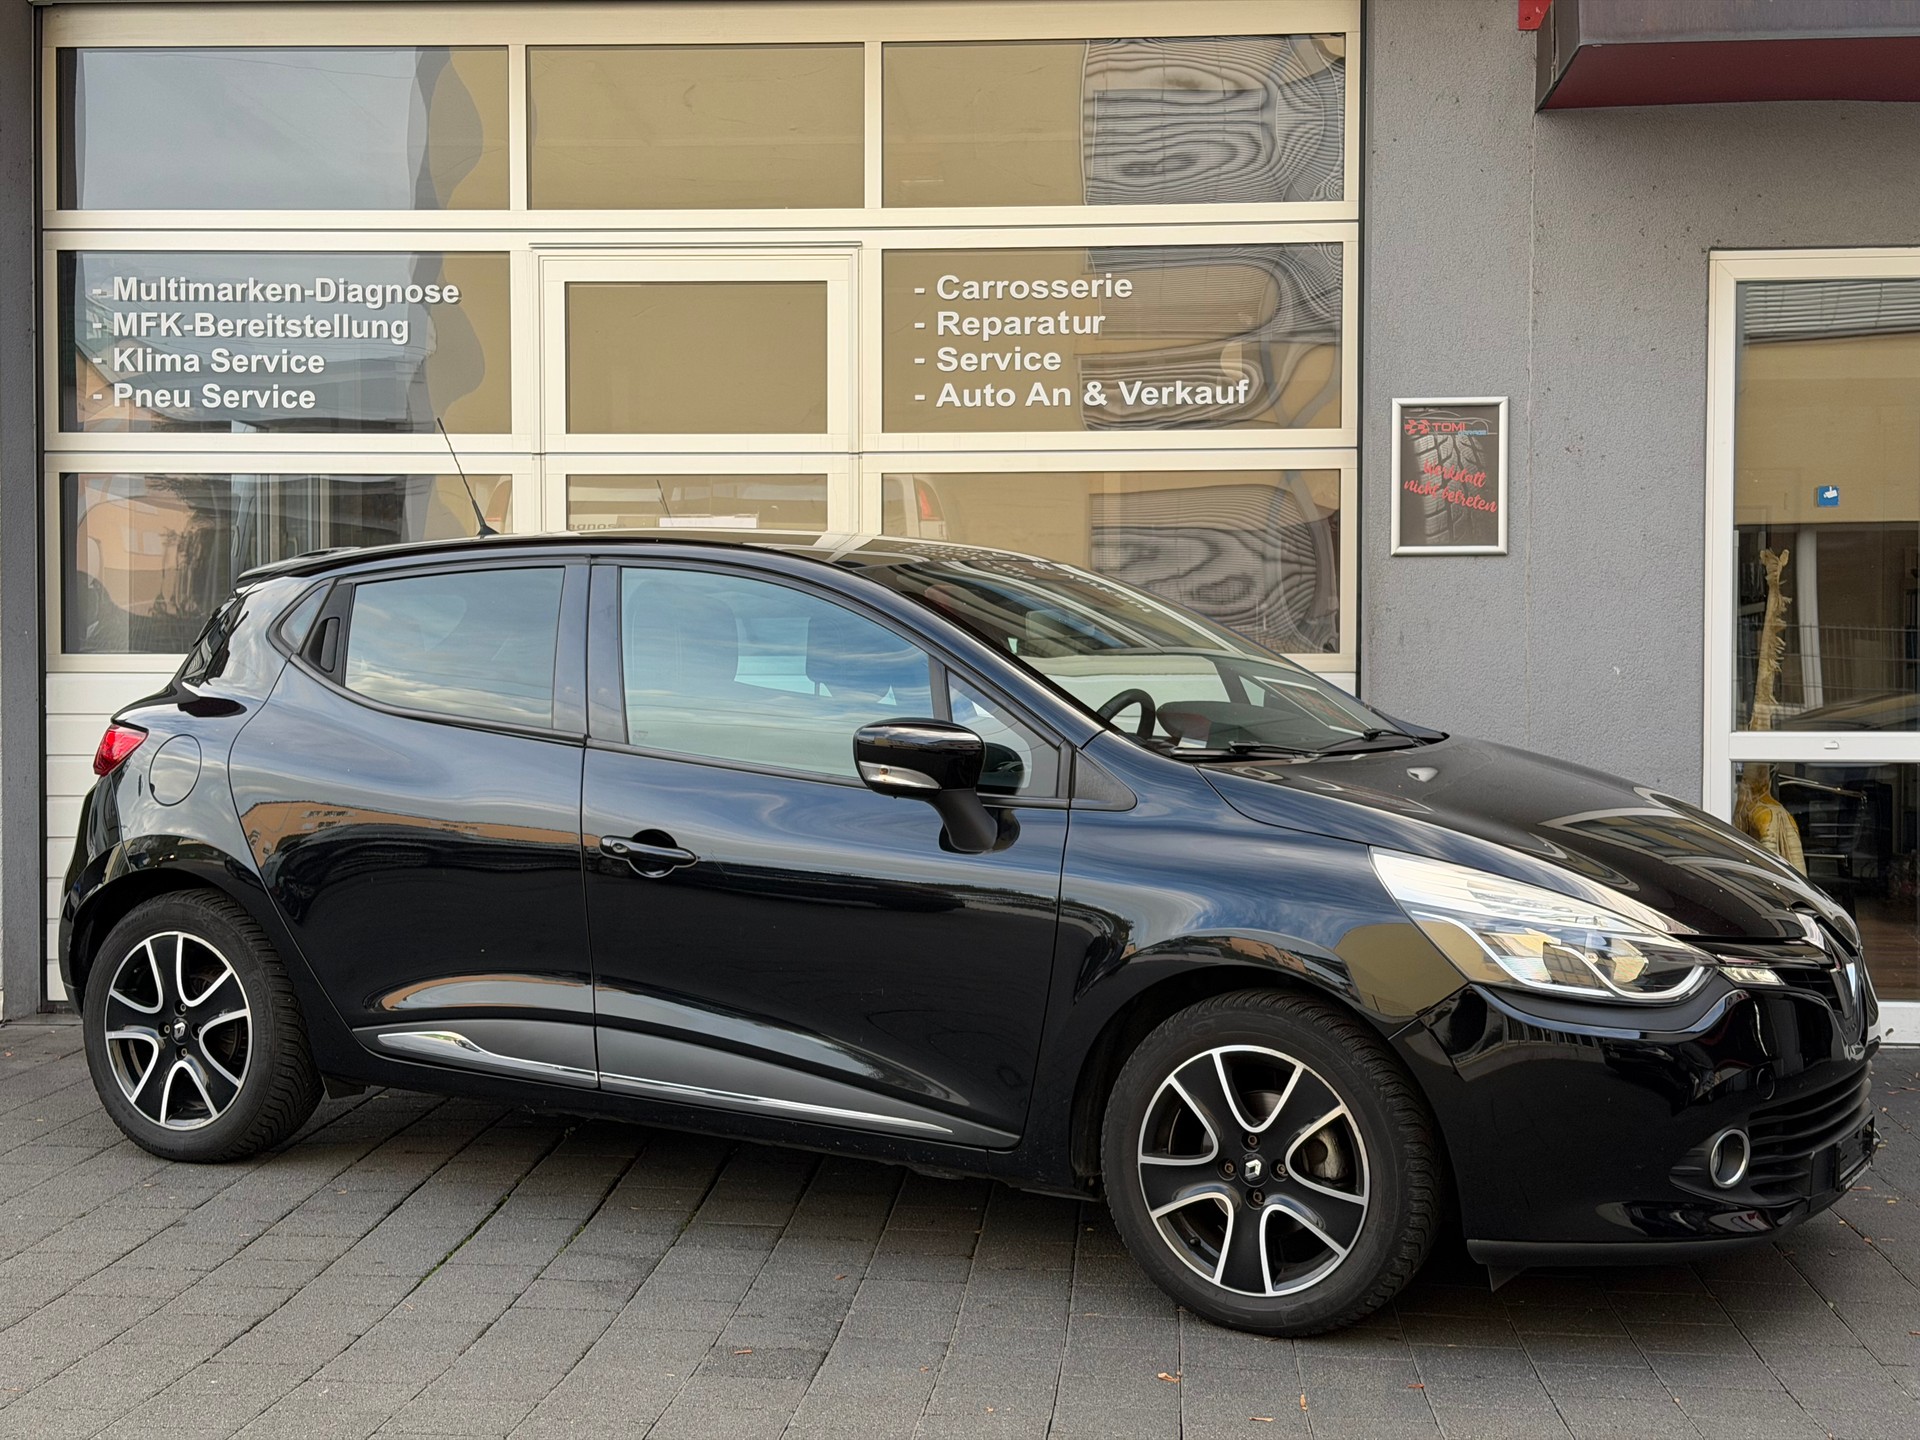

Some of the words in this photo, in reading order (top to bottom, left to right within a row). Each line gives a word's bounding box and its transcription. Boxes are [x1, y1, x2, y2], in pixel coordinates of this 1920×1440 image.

[113, 276, 459, 309] Multimarken-Diagnose
[936, 273, 1133, 300] Carrosserie
[113, 311, 409, 345] MFK-Bereitstellung
[937, 310, 1106, 341] Reparatur
[113, 347, 200, 373] Klima
[210, 347, 325, 374] Service
[936, 346, 1061, 372] Service
[113, 383, 191, 409] Pneu
[201, 383, 316, 410] Service
[936, 383, 1016, 407] Auto
[1025, 382, 1071, 406] An
[1083, 381, 1108, 406] &
[1118, 379, 1250, 406] Verkauf
[1442, 486, 1497, 513] betreten
